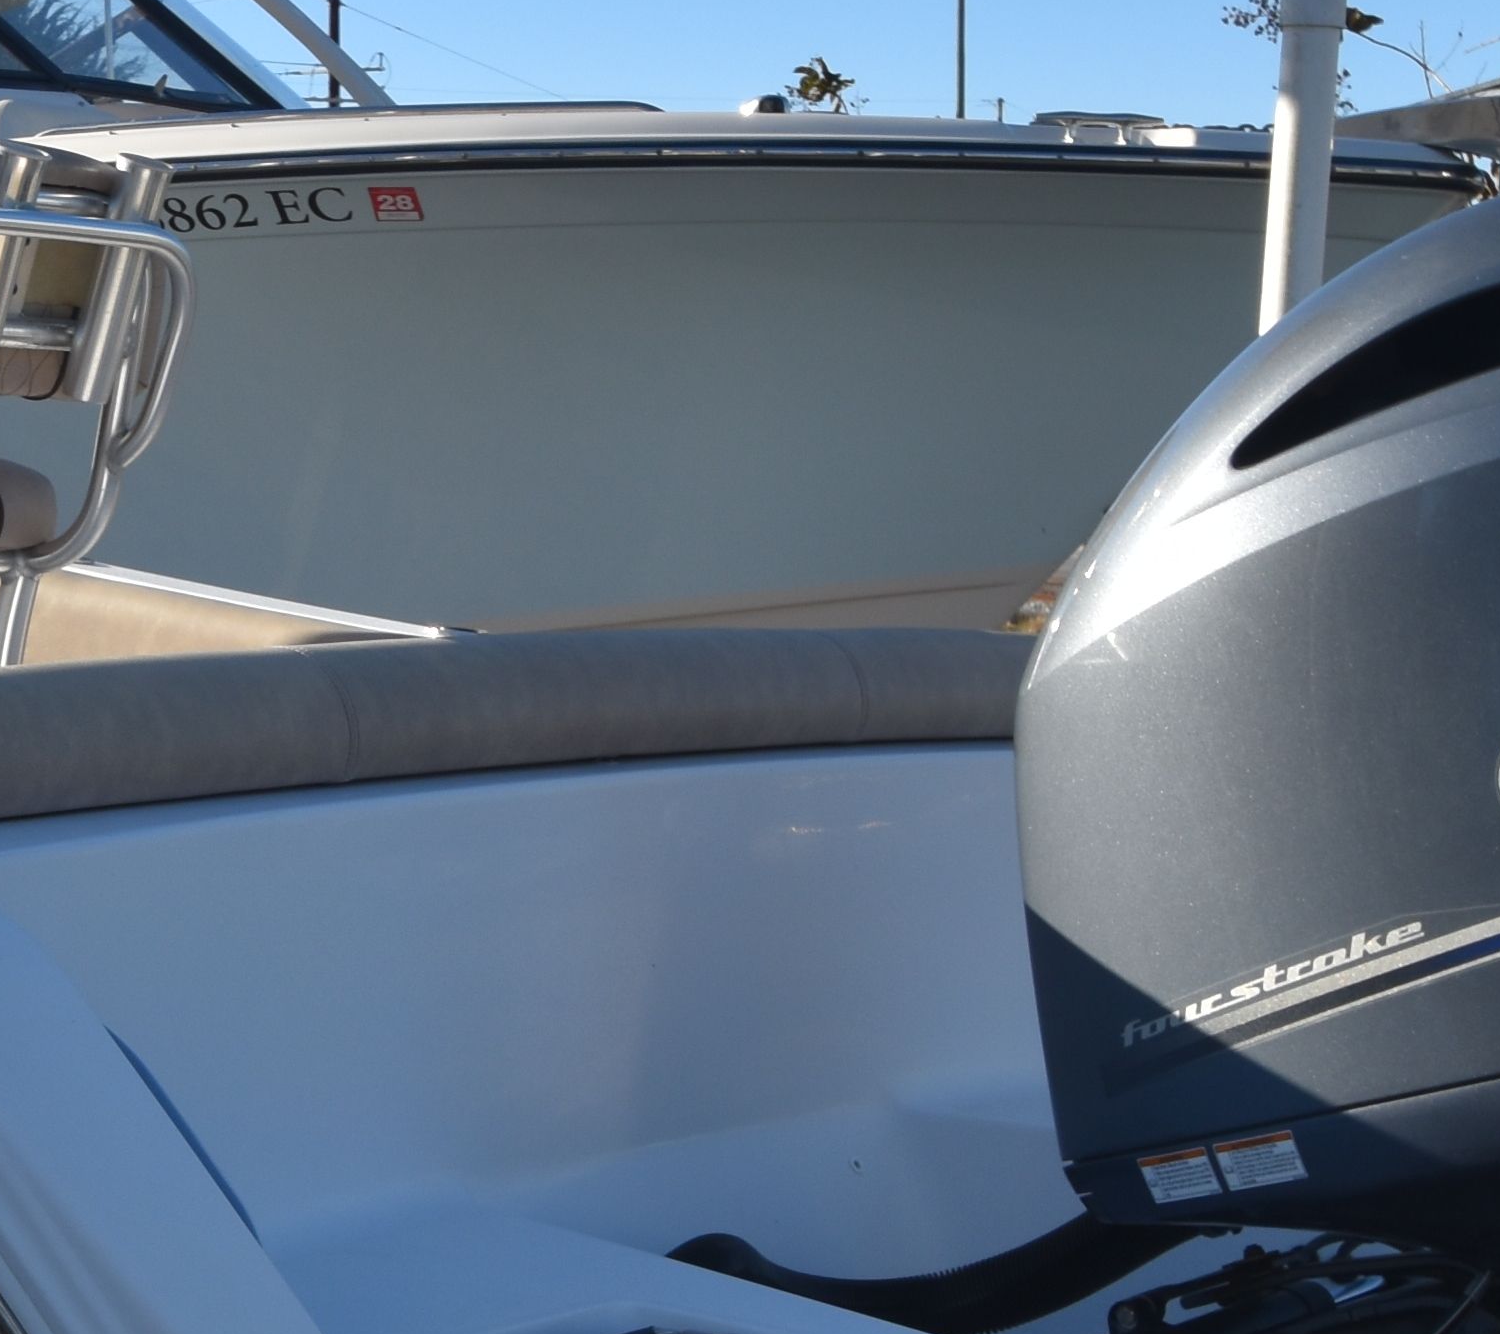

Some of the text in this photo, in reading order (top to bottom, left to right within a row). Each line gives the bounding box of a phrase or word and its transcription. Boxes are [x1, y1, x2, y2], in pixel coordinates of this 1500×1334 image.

[160, 186, 353, 233] 862 EC
[376, 194, 416, 211] 28
